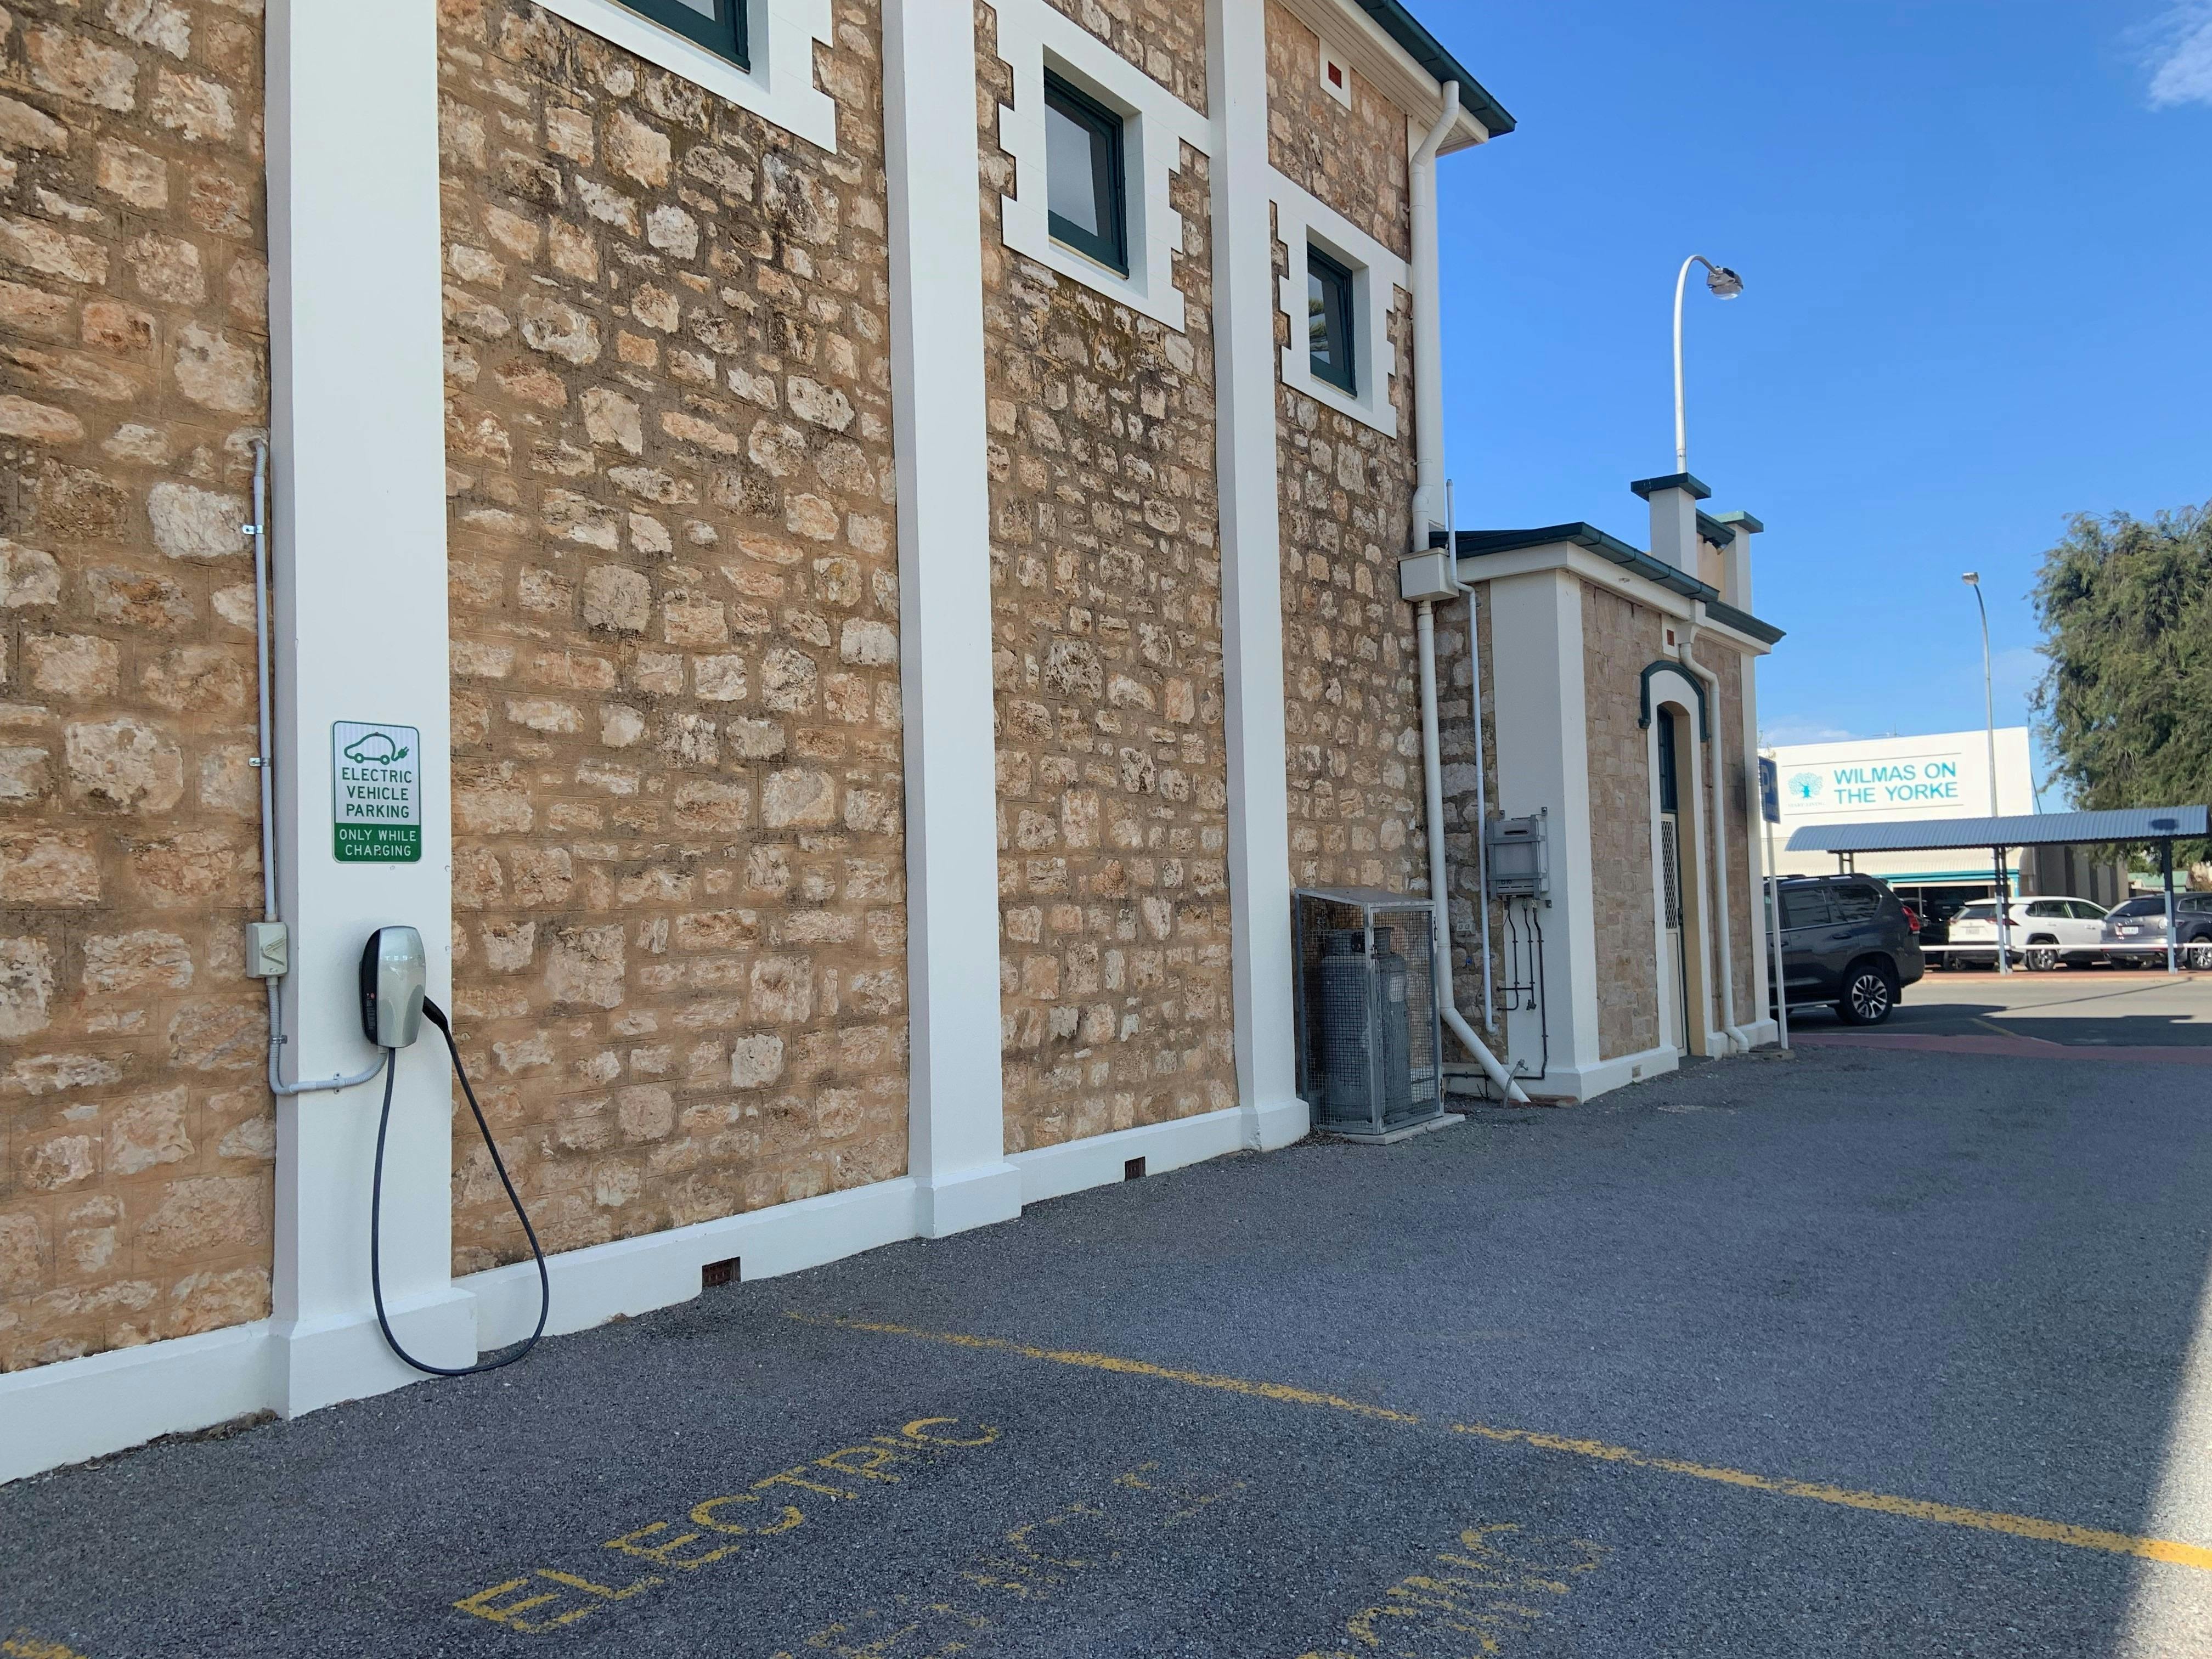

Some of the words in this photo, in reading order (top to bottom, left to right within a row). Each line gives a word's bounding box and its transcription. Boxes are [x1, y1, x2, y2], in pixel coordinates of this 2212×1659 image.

[342, 767, 412, 783] ELECTRIC
[1833, 764, 1916, 785] WILMAS
[1925, 761, 1956, 779] ON
[346, 785, 409, 801] VEHICLE
[1834, 787, 1876, 805] THE
[1884, 782, 1959, 802] YORKE
[346, 803, 409, 819] PARKING
[339, 828, 373, 841] ONLY
[379, 830, 416, 842] WHILE
[345, 844, 411, 857] CHARGING
[453, 1417, 1000, 1633] ELECTRIC
